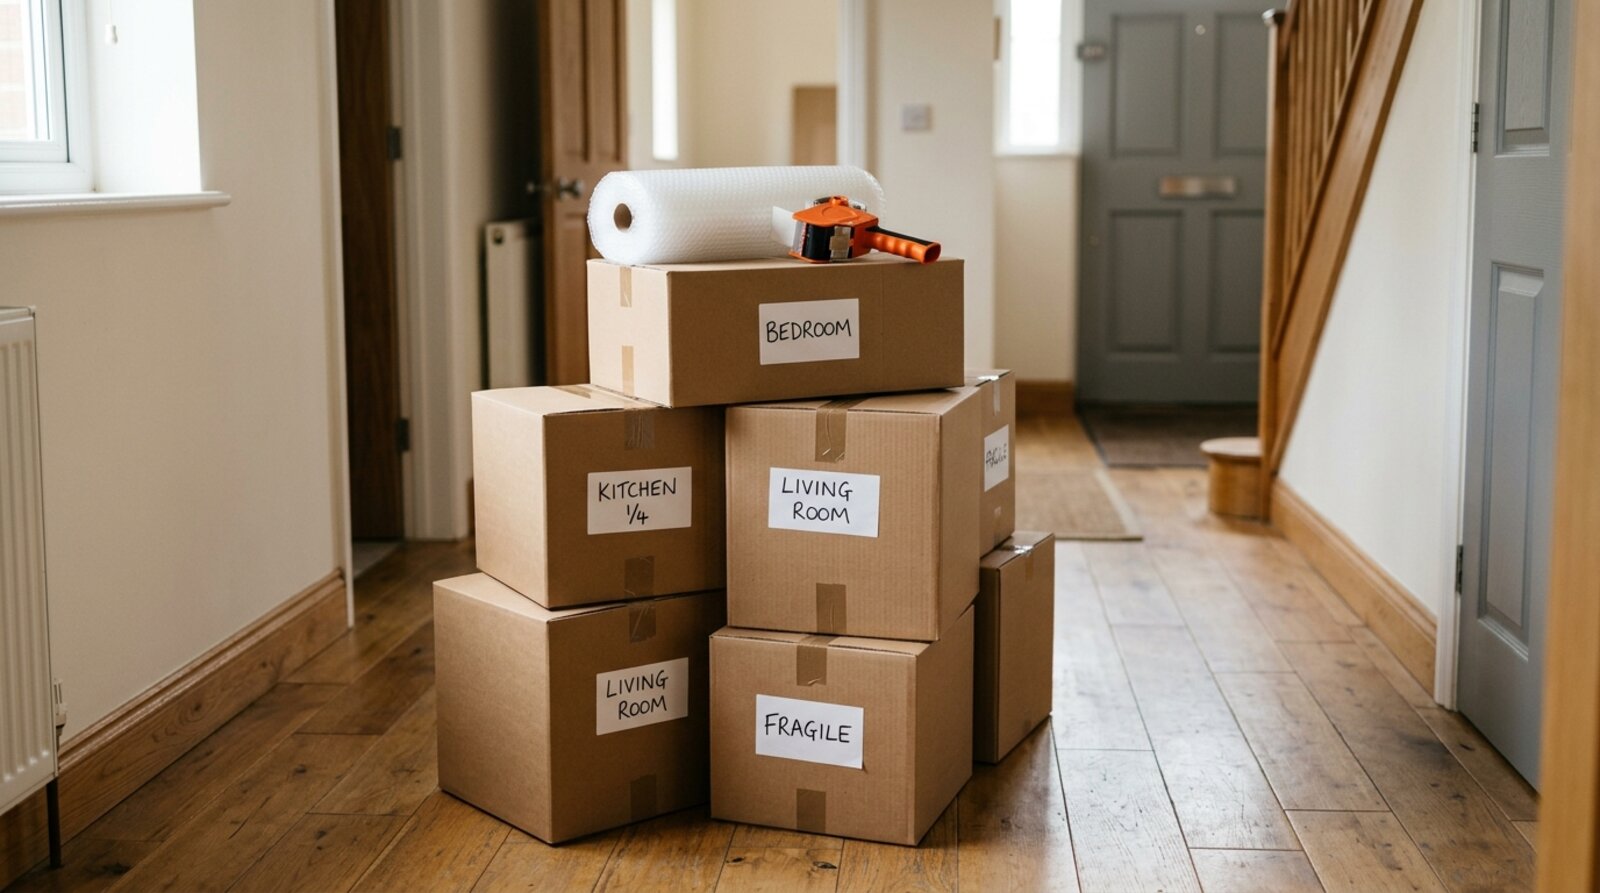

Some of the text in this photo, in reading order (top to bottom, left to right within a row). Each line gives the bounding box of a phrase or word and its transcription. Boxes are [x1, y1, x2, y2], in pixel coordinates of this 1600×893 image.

[765, 318, 852, 344] BEDROOM
[598, 476, 677, 503] KITCHEN
[781, 477, 853, 503] LIVING
[793, 501, 850, 524] ROOM
[606, 669, 670, 698] LIVING
[617, 695, 668, 721] ROOM
[764, 712, 852, 744] FRAGILE
